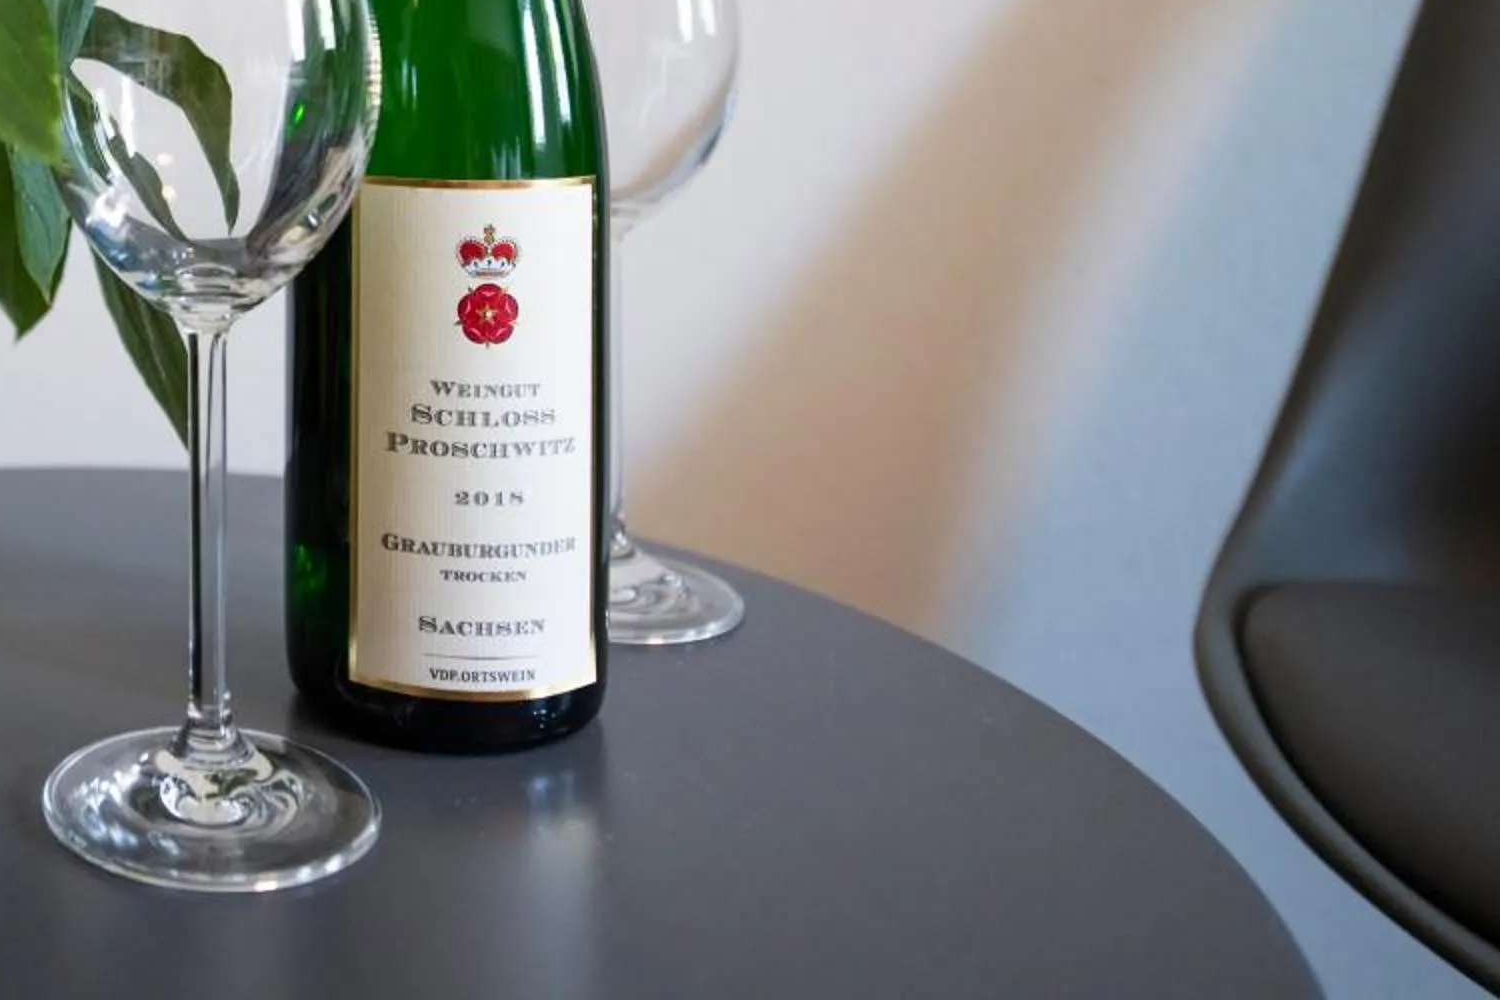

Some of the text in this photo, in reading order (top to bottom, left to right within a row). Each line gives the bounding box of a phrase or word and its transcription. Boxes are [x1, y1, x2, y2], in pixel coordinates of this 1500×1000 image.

[429, 379, 542, 399] WEINGUT
[410, 402, 556, 428] SCHLOSS
[386, 431, 576, 460] PROSCHWITZ
[453, 490, 525, 507] 2018
[381, 532, 577, 560] GRAUBURGUNDER
[438, 569, 528, 583] TROCKEN
[417, 614, 546, 638] SACHSEN
